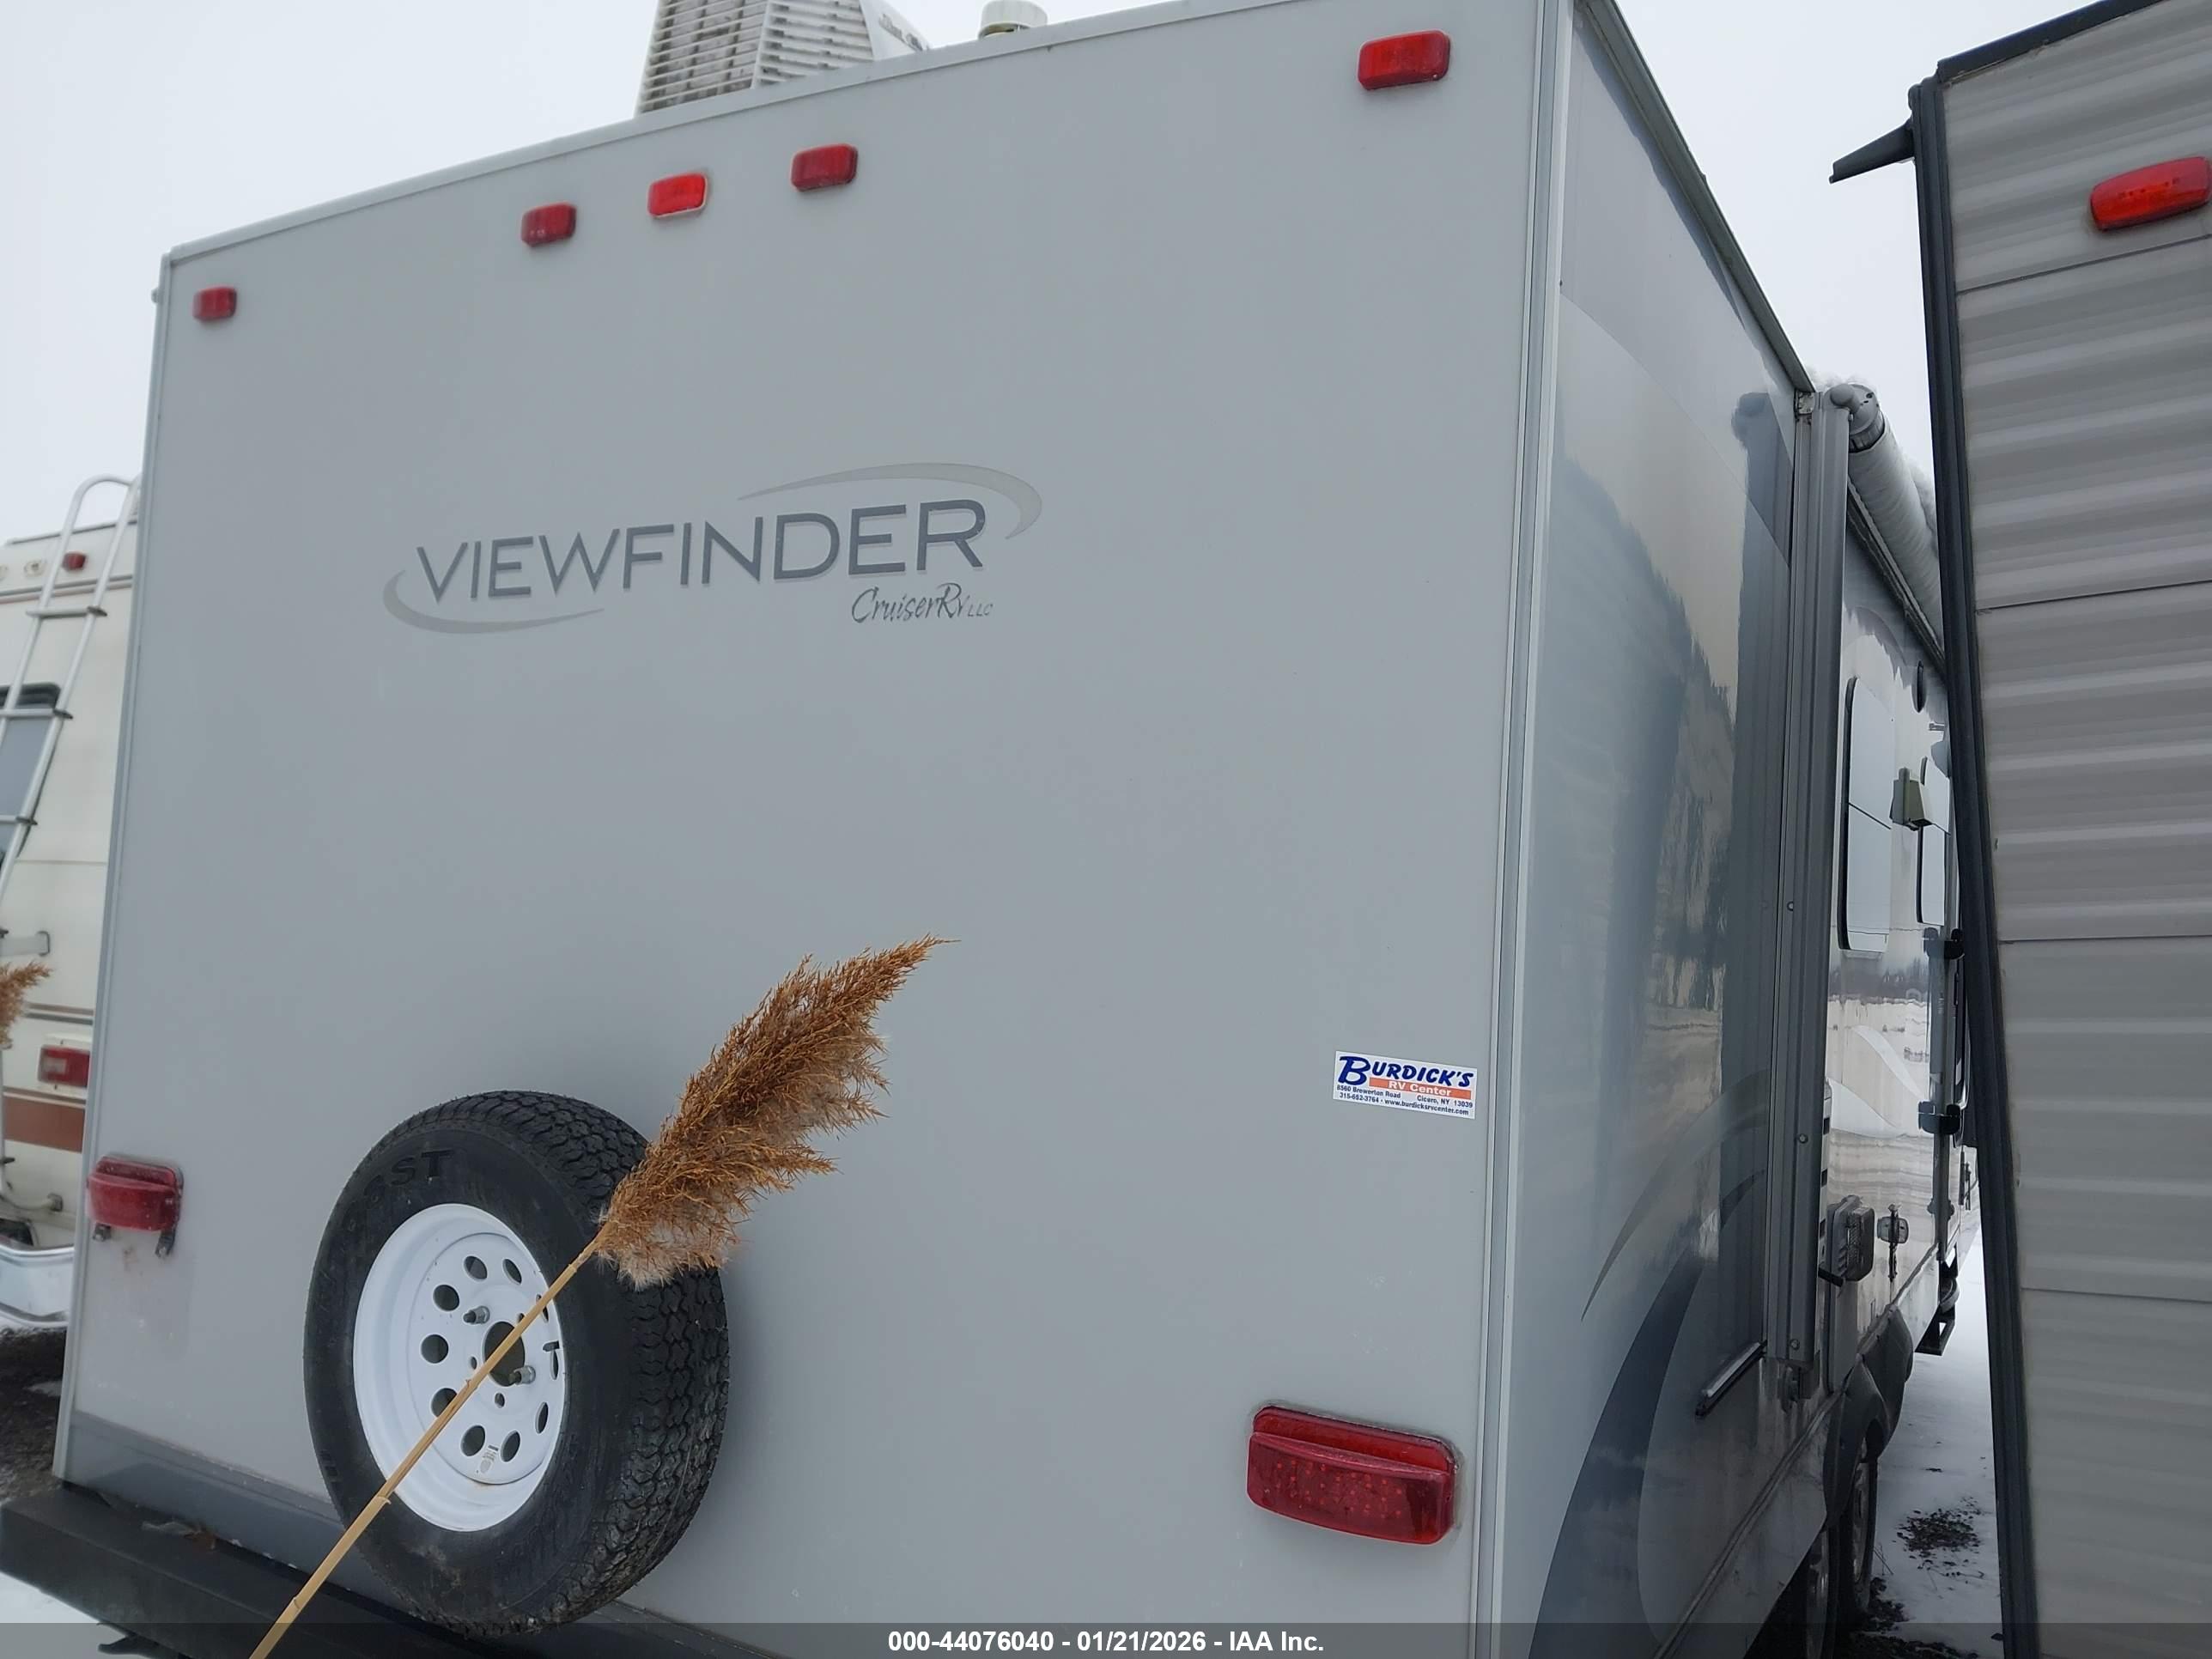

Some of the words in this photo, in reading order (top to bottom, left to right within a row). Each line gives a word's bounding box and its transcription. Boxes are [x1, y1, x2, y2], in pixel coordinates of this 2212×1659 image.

[417, 499, 987, 603] VIEWFINDER
[1338, 1055, 1474, 1087] BURDICK'S
[1352, 1086, 1383, 1097] Brewerton
[1389, 1080, 1407, 1091] RV
[1409, 1084, 1452, 1097] Center
[1384, 1099, 1469, 1115] www.burdicksrvcenter.com
